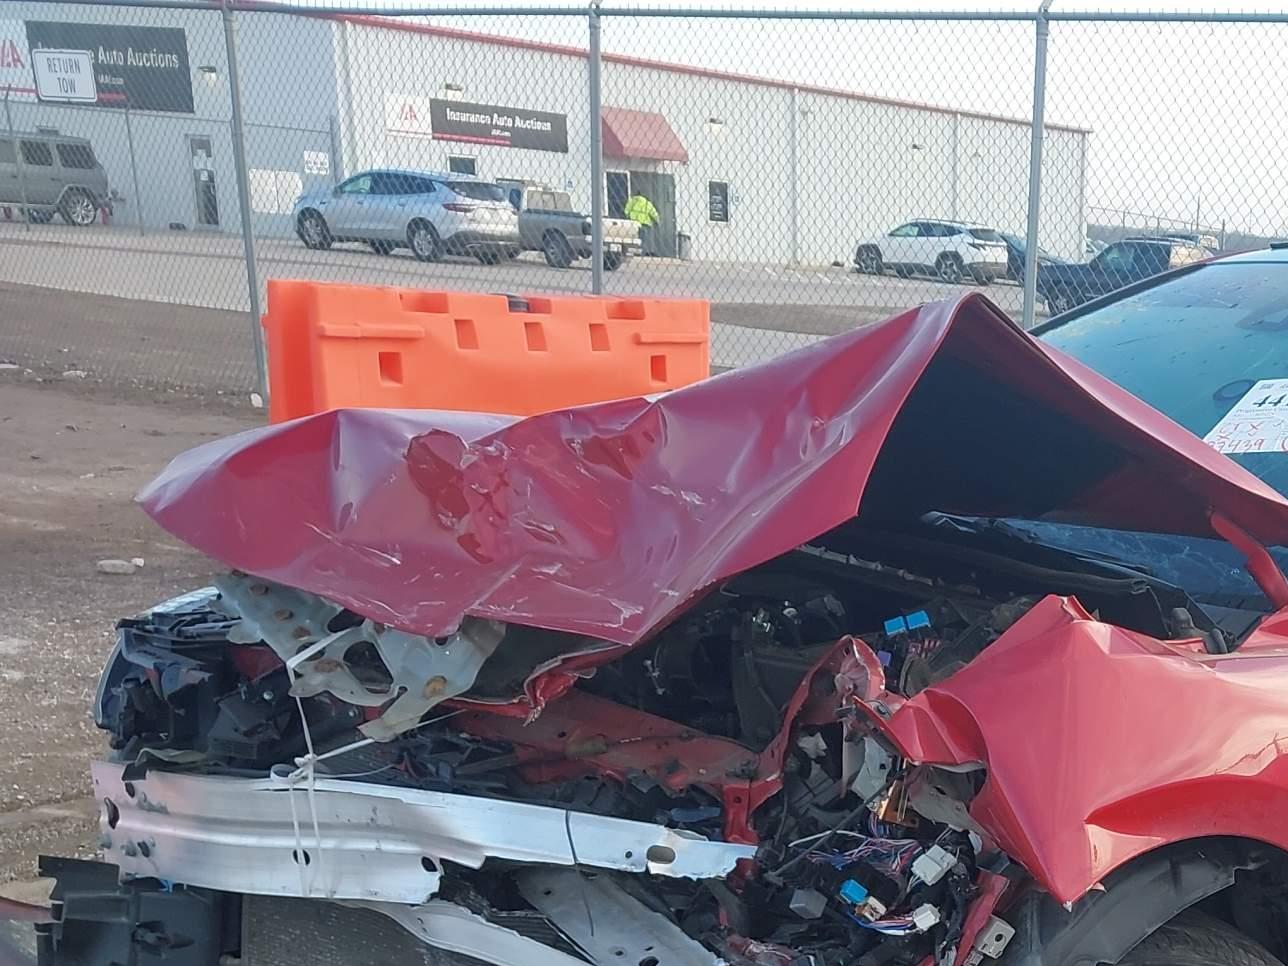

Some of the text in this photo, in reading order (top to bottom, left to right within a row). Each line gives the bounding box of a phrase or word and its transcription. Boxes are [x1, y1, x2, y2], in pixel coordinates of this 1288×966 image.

[46, 57, 80, 74] RETURN
[98, 46, 124, 65] Auto
[127, 47, 179, 68] Auctions
[57, 77, 76, 94] TOW
[446, 107, 552, 131] Insurance Auto Auctions
